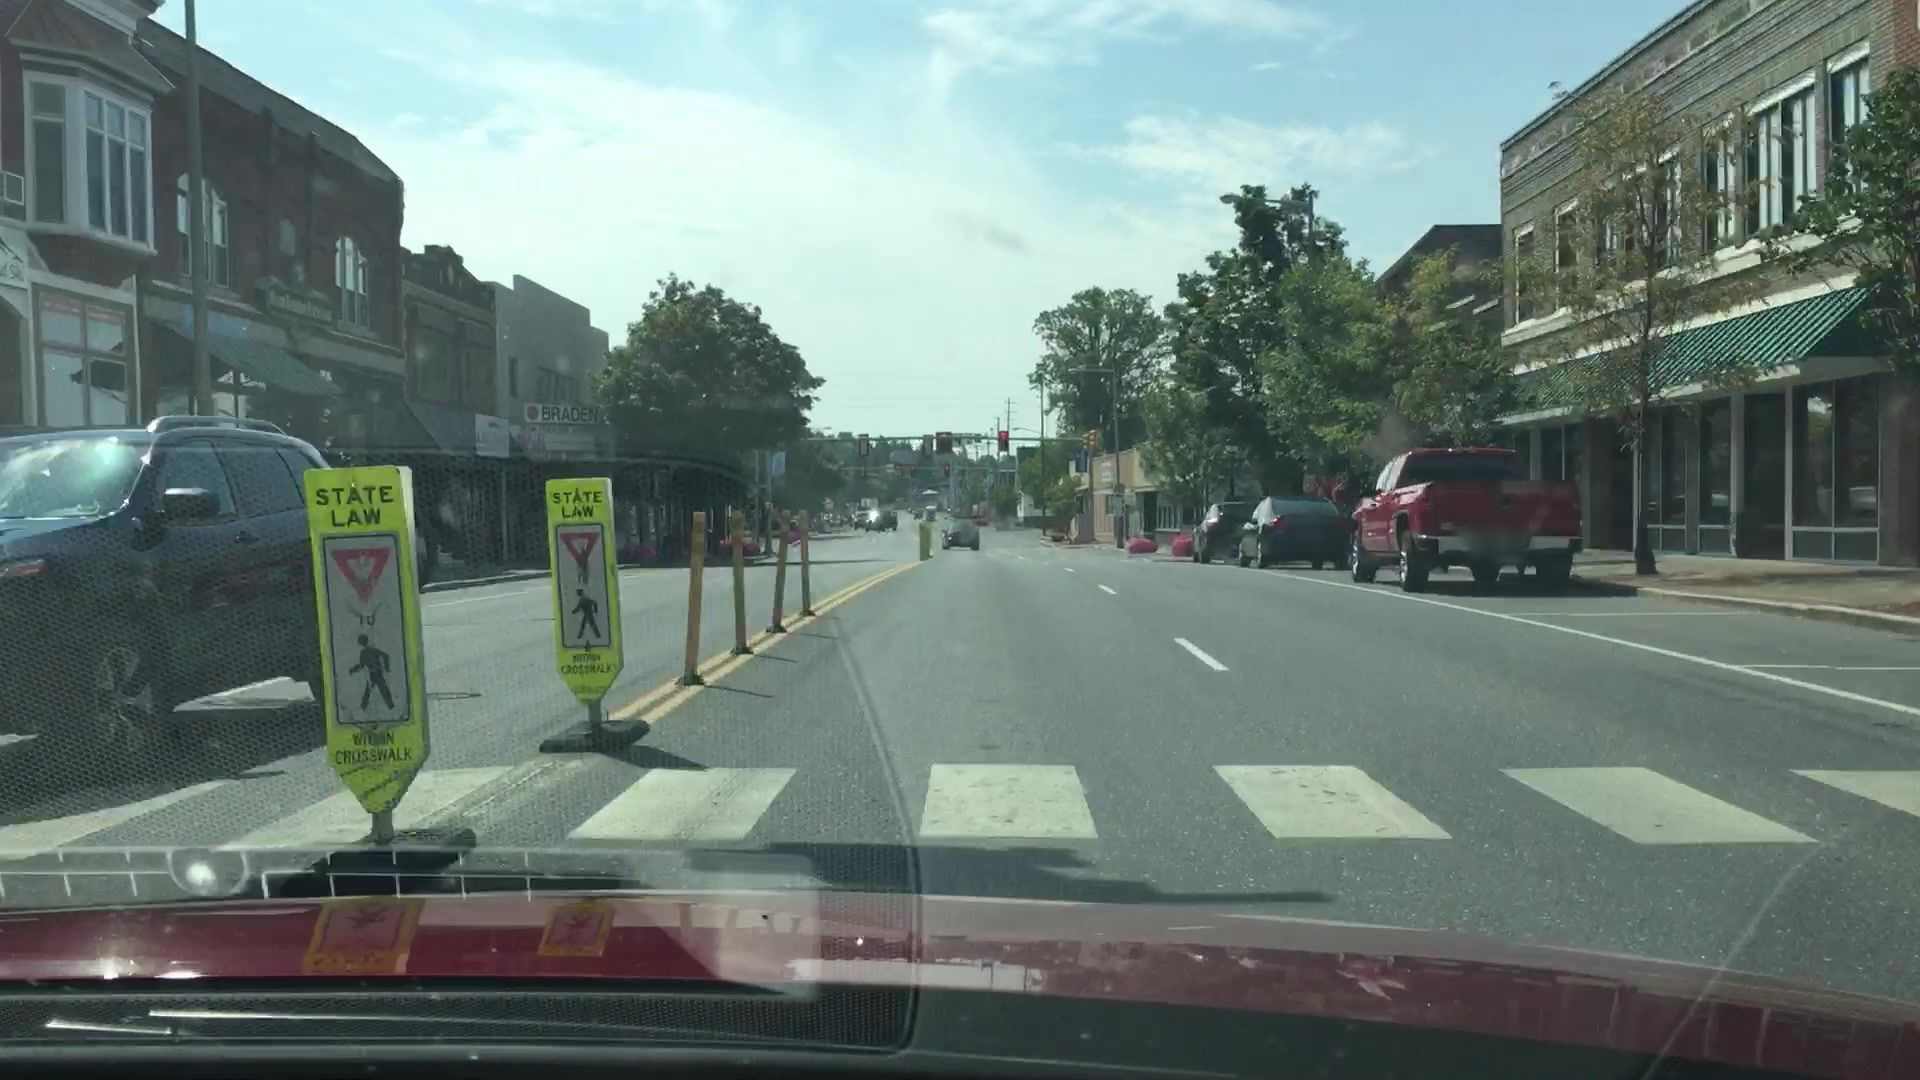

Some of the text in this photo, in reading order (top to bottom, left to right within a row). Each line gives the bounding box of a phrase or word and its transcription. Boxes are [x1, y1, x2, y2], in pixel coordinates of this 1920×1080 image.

[316, 486, 394, 505] STATE
[553, 490, 603, 504] STATE
[331, 508, 381, 527] LAW
[561, 506, 594, 518] LAW
[352, 732, 395, 746] WITIN
[335, 747, 412, 764] CROSSWALK
